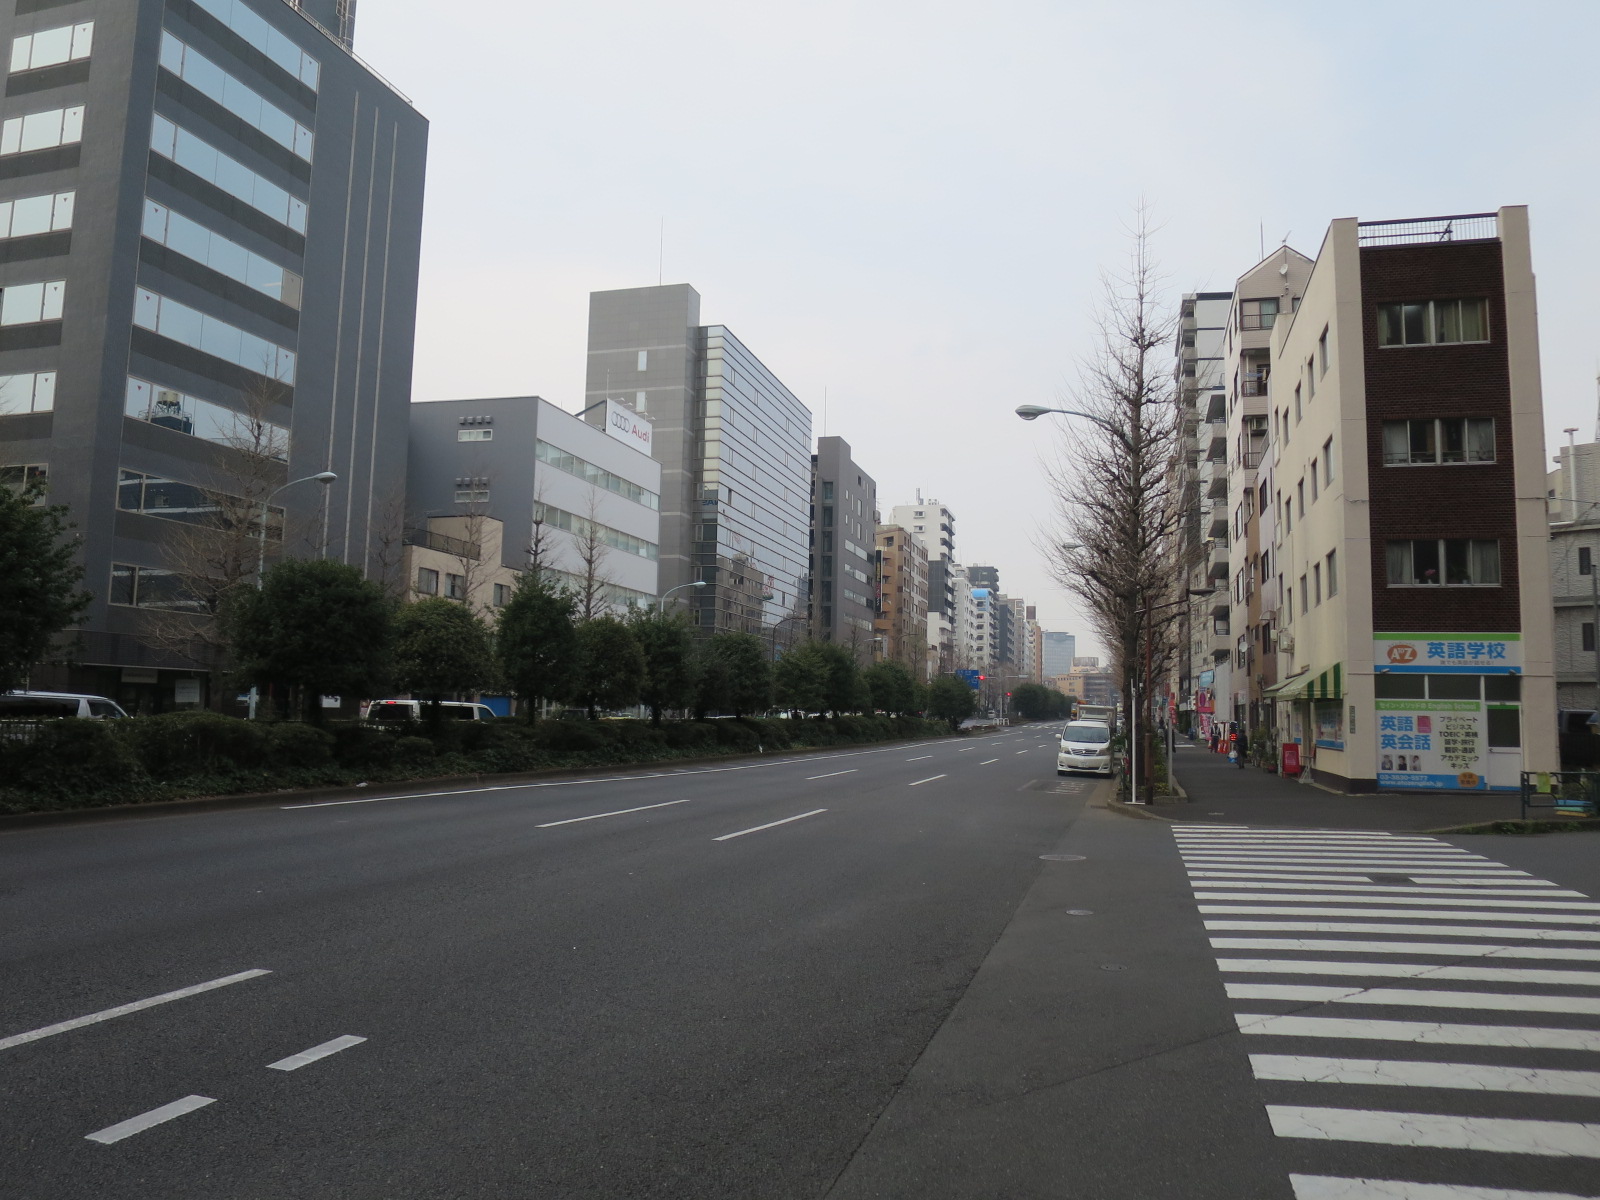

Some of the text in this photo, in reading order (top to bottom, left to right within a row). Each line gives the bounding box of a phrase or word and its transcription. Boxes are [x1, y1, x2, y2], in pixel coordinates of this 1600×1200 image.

[631, 424, 650, 443] Audi
[1427, 642, 1505, 659] 英語学校
[1380, 715, 1414, 732] 英語
[1439, 716, 1479, 724] プライベート
[1446, 723, 1473, 731] ビジネス
[1380, 734, 1431, 751] 英会話
[1440, 754, 1480, 762] アカデミック
